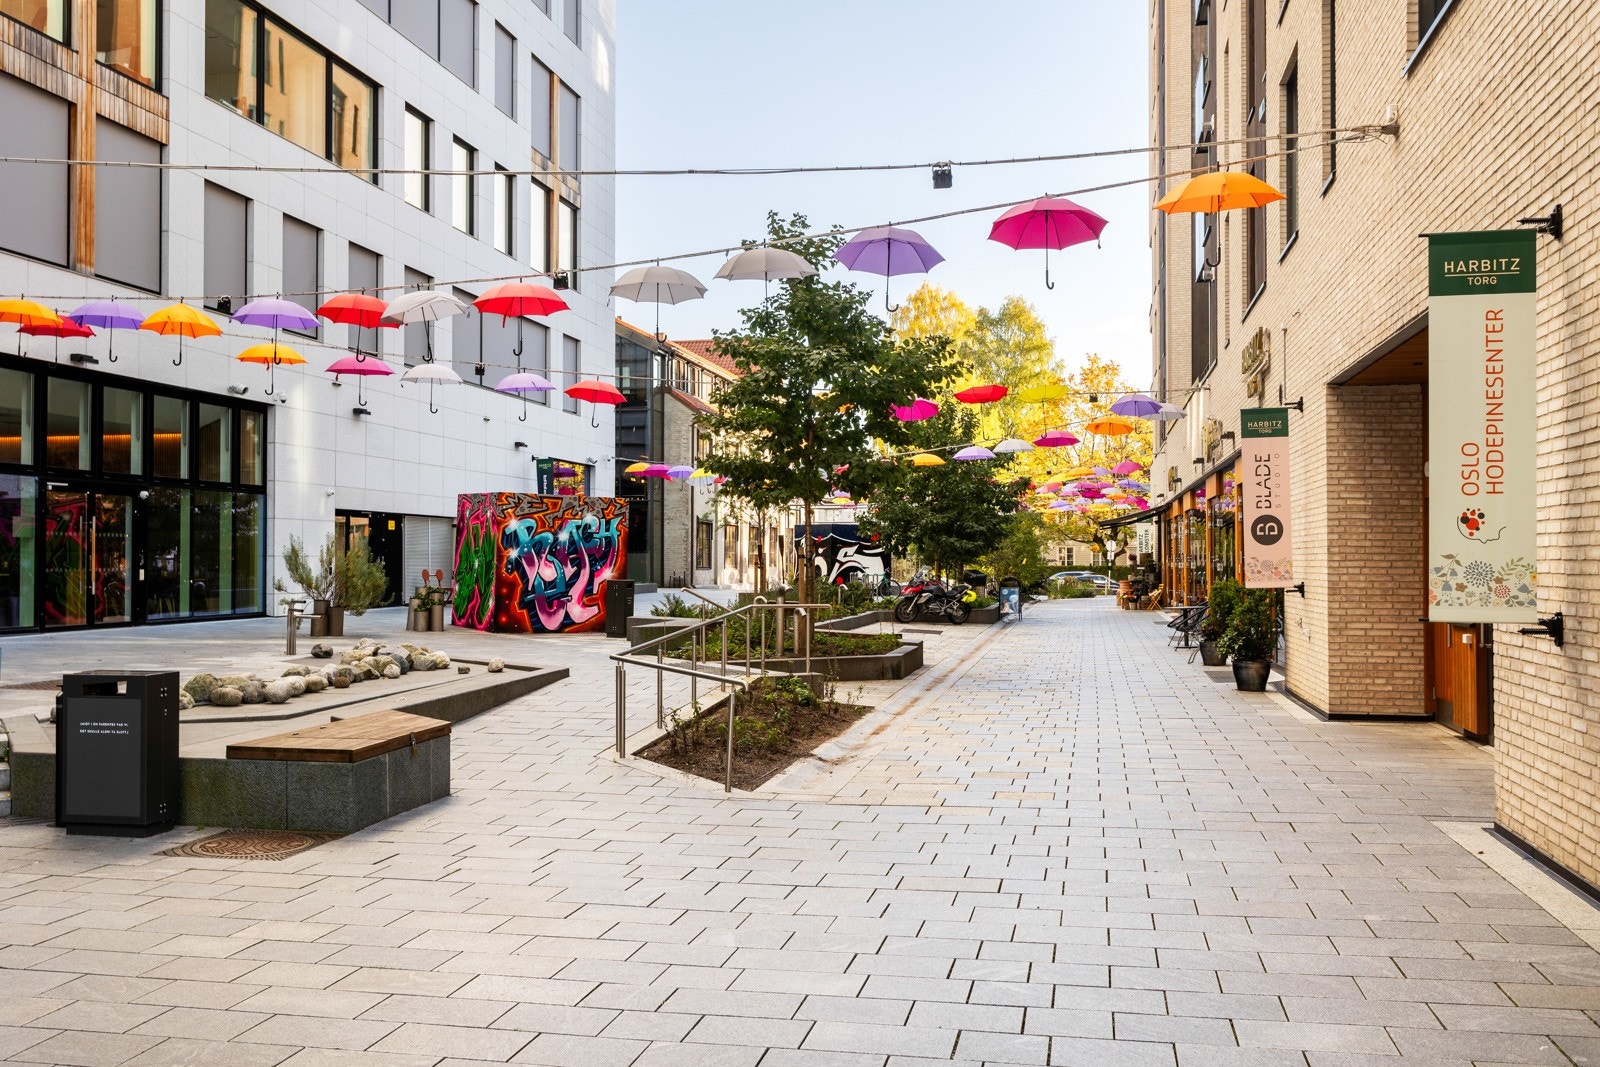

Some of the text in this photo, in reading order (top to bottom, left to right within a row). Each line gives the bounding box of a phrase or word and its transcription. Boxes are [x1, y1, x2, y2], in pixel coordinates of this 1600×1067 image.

[1444, 258, 1520, 273] HARBITZ
[1467, 276, 1497, 286] TORG
[1485, 308, 1504, 495] HODEPINESENTER
[1247, 420, 1282, 428] HARBITZ
[1254, 454, 1272, 508] BLADE
[1461, 442, 1480, 496] OSLO
